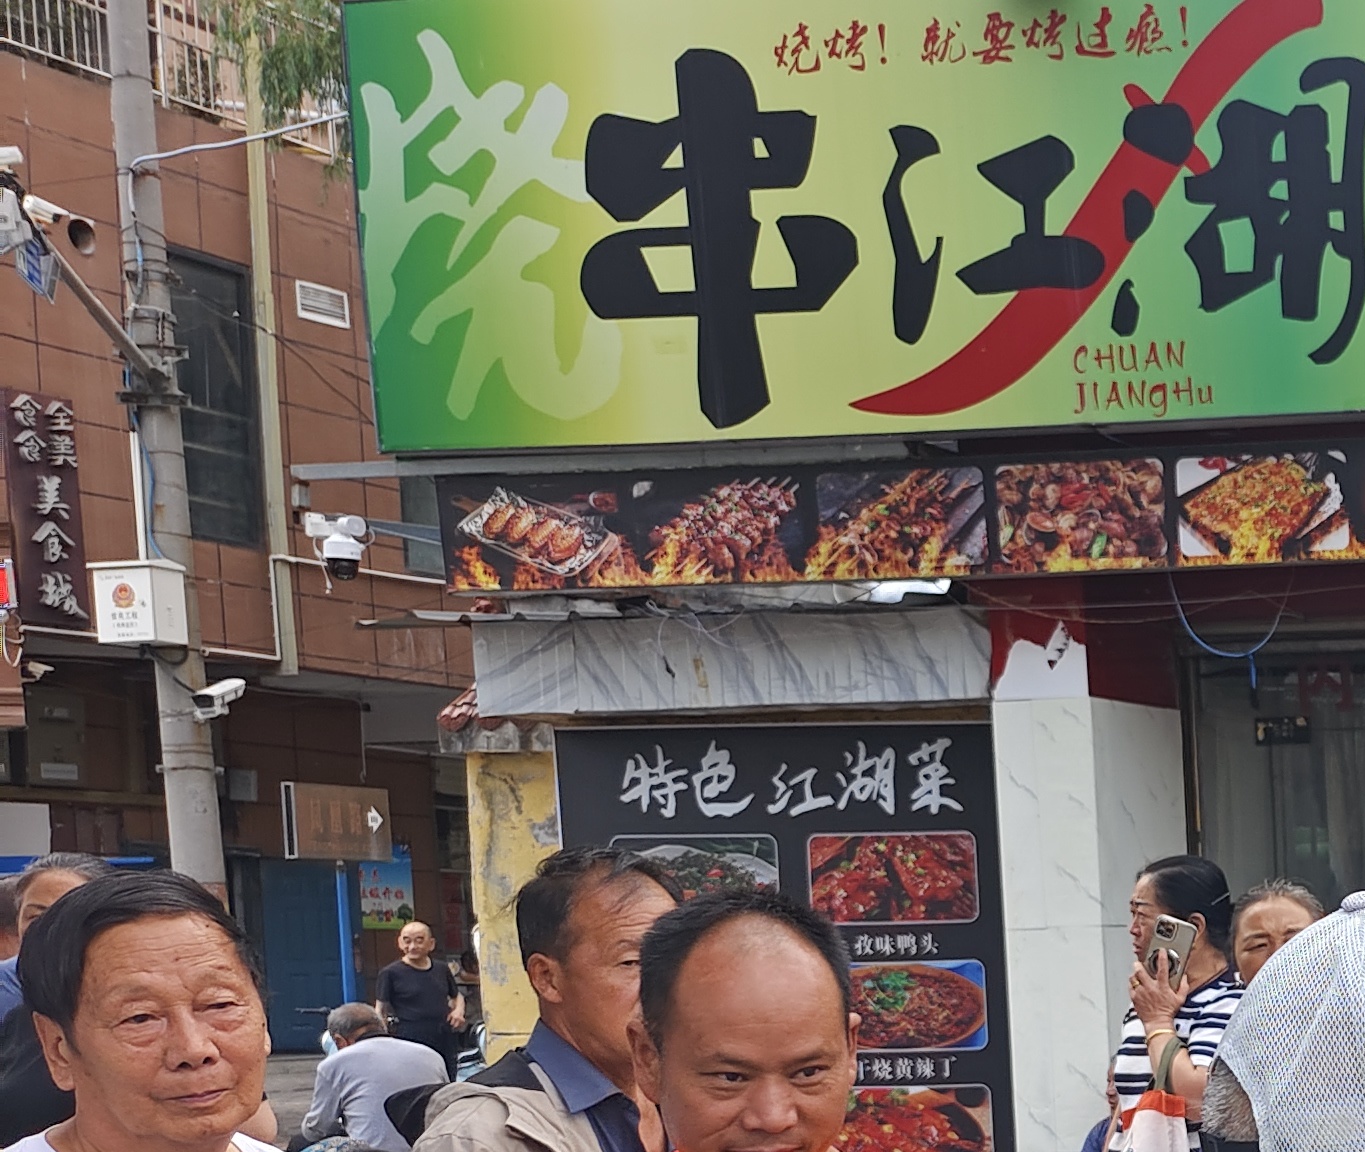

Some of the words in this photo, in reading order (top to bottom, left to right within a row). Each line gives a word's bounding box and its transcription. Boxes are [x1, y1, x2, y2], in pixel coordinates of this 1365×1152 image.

[1073, 342, 1186, 375] CHUAN
[31, 475, 90, 620] 美食城
[620, 737, 964, 819] 特色江湖菜
